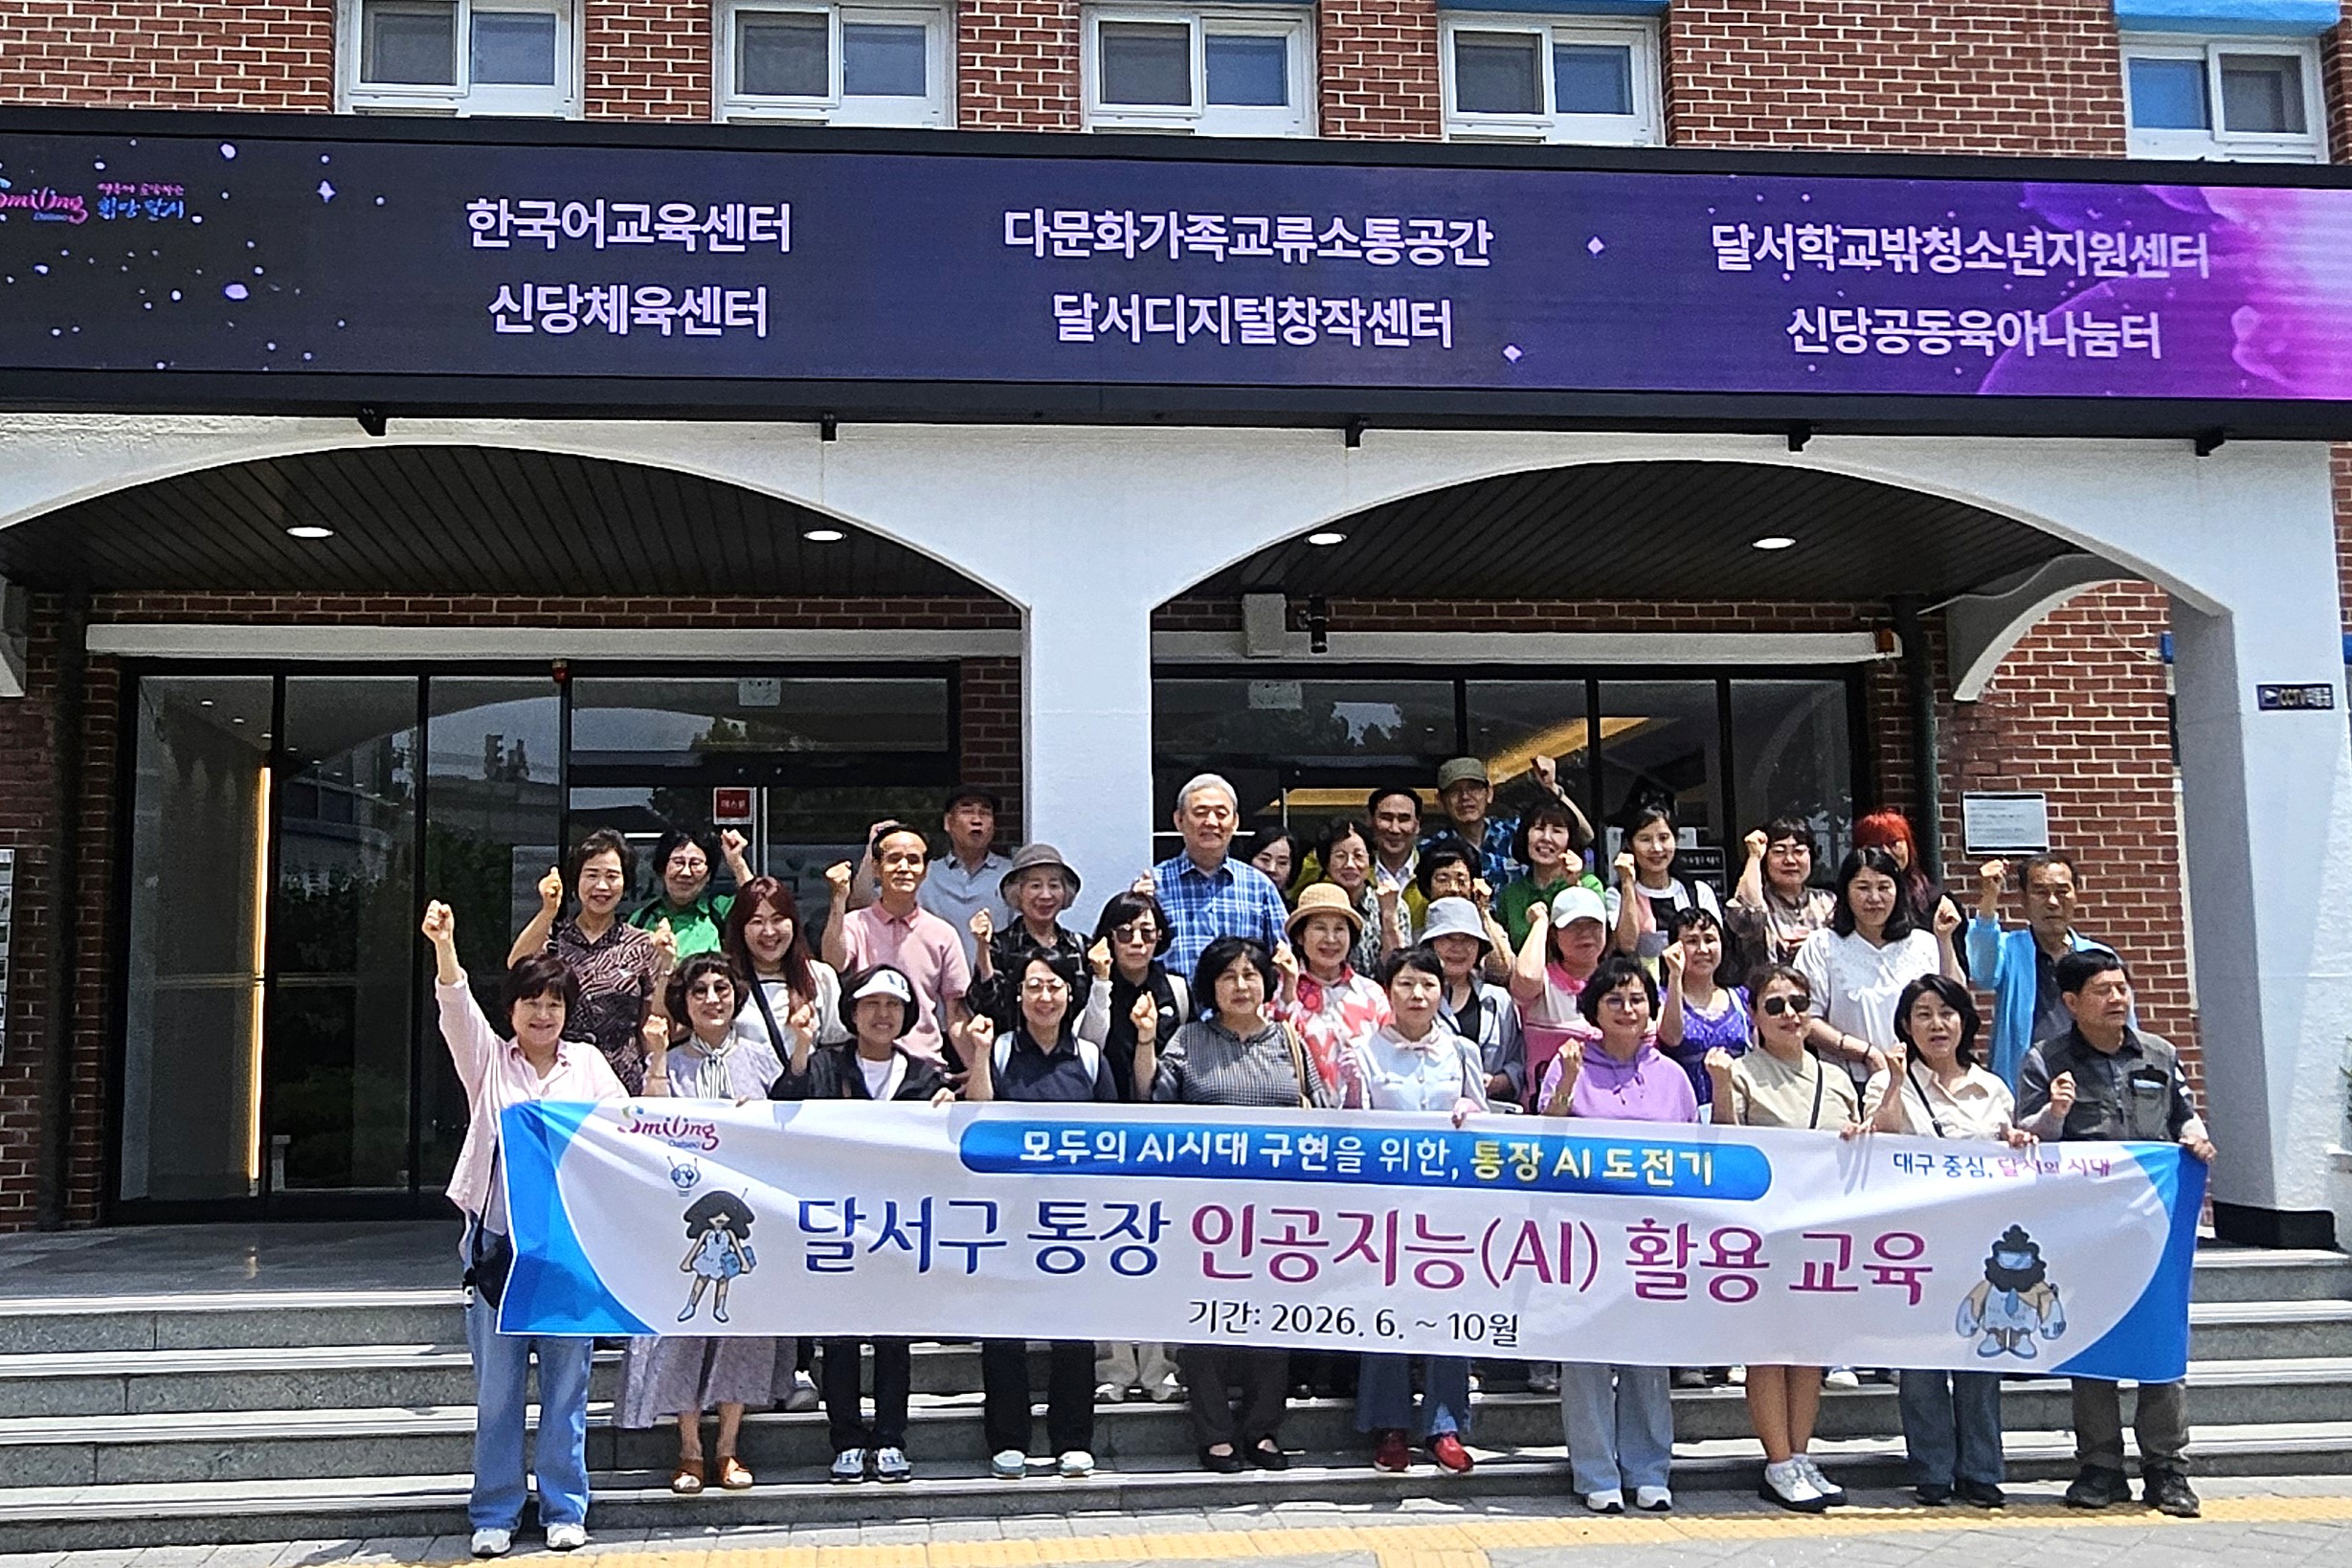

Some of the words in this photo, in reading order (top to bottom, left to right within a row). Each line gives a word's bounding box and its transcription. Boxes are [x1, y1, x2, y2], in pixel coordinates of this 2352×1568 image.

[466, 198, 792, 253] 한국어교육센터
[1004, 209, 1494, 267] 다문화가족교류소통공간
[1712, 223, 2210, 279] 달서학교밖청소년지원센터
[488, 284, 768, 338] 신당체육센터
[1053, 293, 1452, 349] 달서디지털창작센터
[1786, 306, 2162, 359] 신당공동육아나눔터
[617, 1106, 720, 1151] Smiling
[1019, 1130, 1127, 1165] 모두의
[1136, 1131, 1248, 1165] AI시대
[1259, 1132, 1366, 1175] 구현을
[1378, 1136, 1461, 1181] 위한,
[1469, 1140, 1543, 1181] 통장
[1553, 1146, 1591, 1178] AI
[1602, 1143, 1714, 1188] 도전기
[1893, 1153, 1936, 1176] 대구
[1942, 1154, 1994, 1179] 중심,
[797, 1197, 1008, 1276] 달서구
[1026, 1199, 1172, 1277] 통장
[1191, 1202, 1601, 1293] 인공지능(AI)
[1624, 1217, 1771, 1305] 활용
[1788, 1232, 1934, 1307] 교육
[1188, 1300, 1263, 1335] 기간:
[1271, 1304, 1365, 1338] 2026.
[1376, 1310, 1405, 1340] 6.
[1449, 1312, 1519, 1349] 10월
